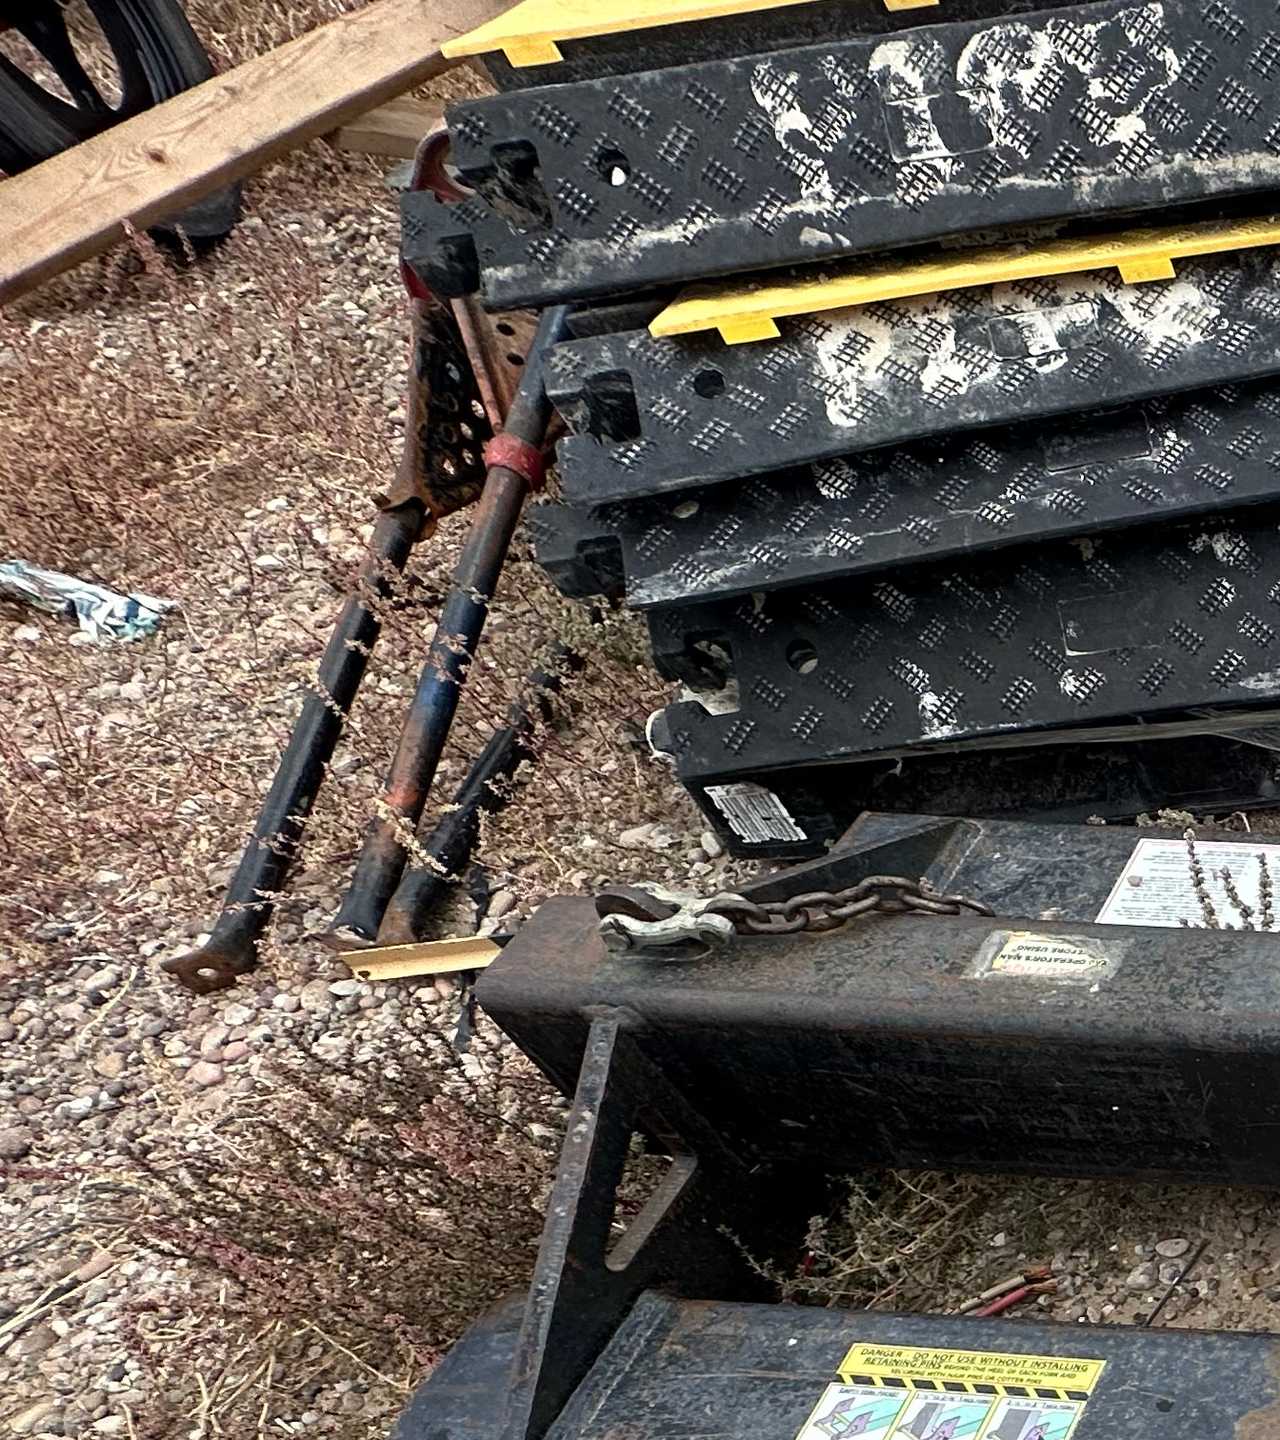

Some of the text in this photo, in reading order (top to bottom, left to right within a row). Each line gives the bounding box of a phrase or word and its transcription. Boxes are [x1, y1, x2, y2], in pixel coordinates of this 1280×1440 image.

[861, 1348, 1088, 1372] DANGER DO NOT USE WITHOUT INSTALLING
[863, 1357, 917, 1368] RETAINING
[919, 1360, 941, 1370] PINS
